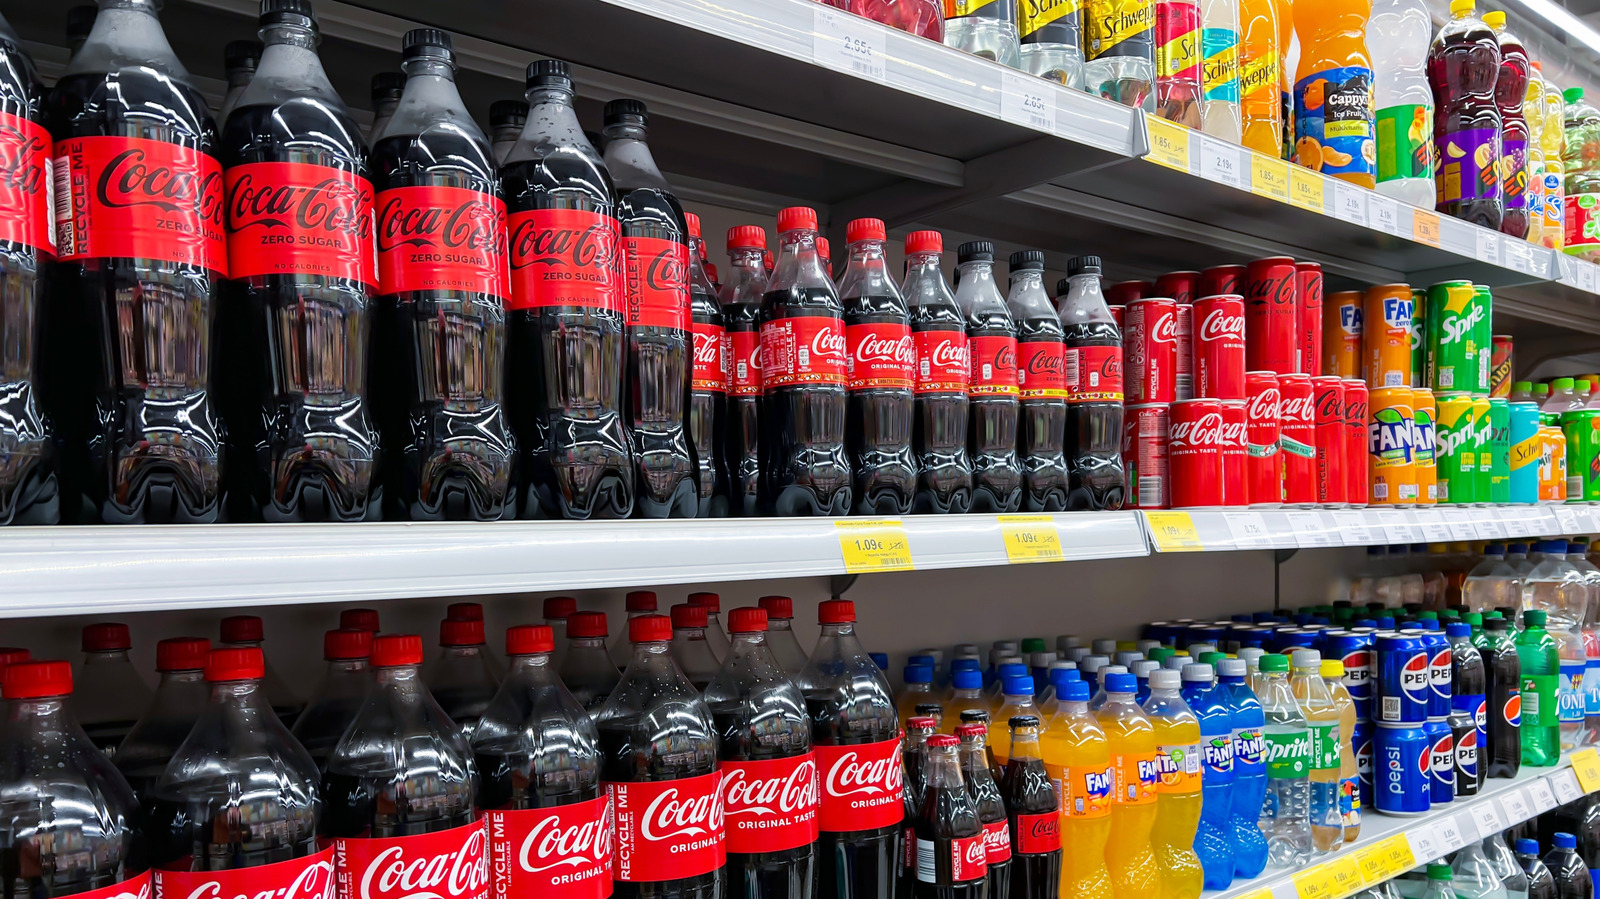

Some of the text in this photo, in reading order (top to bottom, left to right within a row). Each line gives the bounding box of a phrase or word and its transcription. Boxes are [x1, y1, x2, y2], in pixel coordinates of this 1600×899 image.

[1240, 63, 1276, 89] weppe
[1328, 94, 1364, 106] Cappy
[71, 142, 88, 254] RECYCLE ME
[228, 173, 371, 239] Coca-Cola
[157, 219, 192, 232] ZERO
[378, 197, 506, 256] Coca-Cola
[261, 235, 342, 249] ZERO SUGAR
[289, 263, 331, 272] CALORIES
[410, 254, 483, 265] ZERO SUGAR
[437, 279, 475, 287] CALORIES
[543, 273, 608, 283] ZERO SUGAR
[627, 240, 640, 322] RECYCLE ME
[1341, 306, 1363, 327] FA
[1384, 298, 1413, 320] FAN
[786, 321, 792, 335] ME
[1152, 358, 1157, 369] ME
[1516, 442, 1538, 462] Schw
[1319, 447, 1327, 500] RECYCLE ME
[855, 539, 883, 551] 1.09€
[1560, 694, 1584, 710] ONI
[1315, 728, 1320, 738] ME
[1204, 744, 1233, 763] FANT
[1233, 737, 1265, 756] FANT
[1265, 738, 1308, 762] Sprite
[1117, 755, 1122, 767] ME
[1138, 757, 1157, 778] FAN
[1359, 758, 1372, 767] PE
[1385, 747, 1405, 794] pepsi
[1063, 768, 1069, 779] ME
[1085, 767, 1110, 791] FAN
[851, 795, 894, 808] ORIGINAL
[493, 813, 504, 837] ME
[738, 810, 815, 829] ORIGINAL TASTE
[617, 785, 630, 880] RECYCLE ME
[337, 840, 347, 868] ME
[670, 837, 717, 853] ORIGINAL
[953, 841, 958, 851] ME
[551, 866, 603, 885] ORIGINAL
